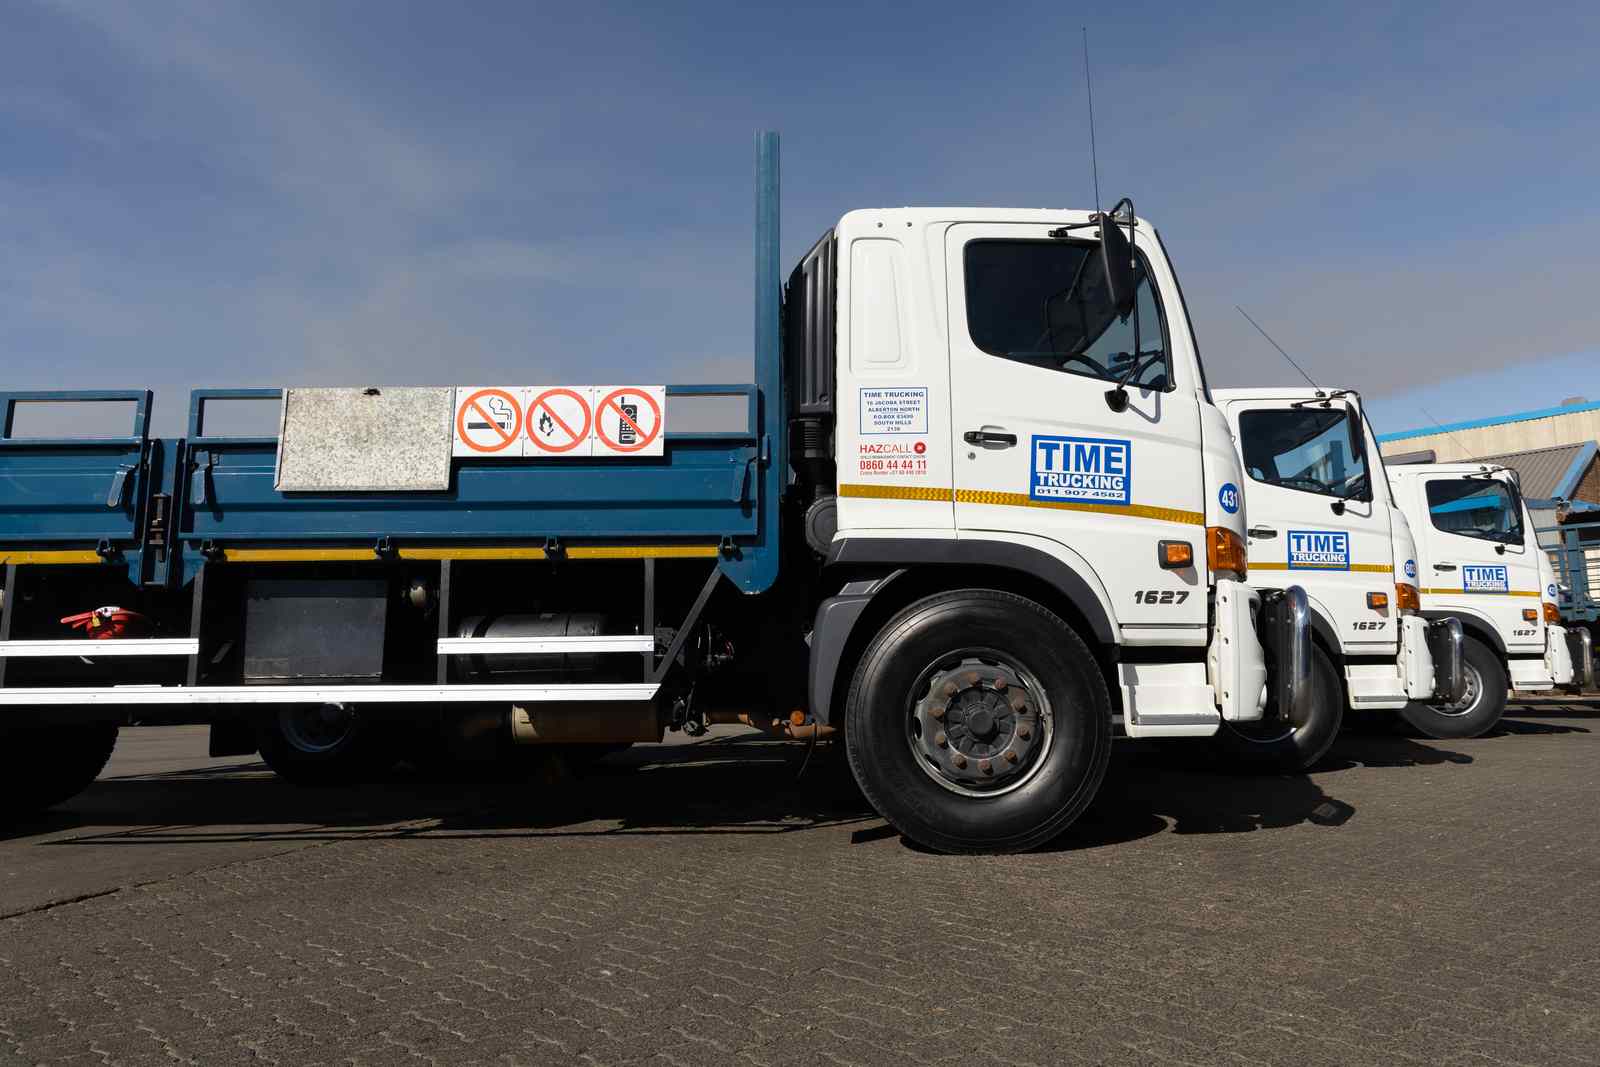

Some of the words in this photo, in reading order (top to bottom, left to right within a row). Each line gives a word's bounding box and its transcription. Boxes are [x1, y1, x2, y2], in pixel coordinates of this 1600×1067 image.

[860, 443, 912, 453] HAZCALL
[860, 460, 883, 470] 0860
[886, 460, 898, 469] 44
[901, 460, 913, 469] 44
[916, 460, 927, 469] 11
[1038, 442, 1124, 474] TIME
[1036, 472, 1124, 490] TRUCKING
[1222, 490, 1239, 508] 431
[1291, 534, 1345, 553] TIME
[1291, 553, 1346, 563] TRUCKING
[1466, 568, 1505, 581] TIME
[1134, 590, 1190, 605] 1627
[1352, 621, 1387, 631] 1627
